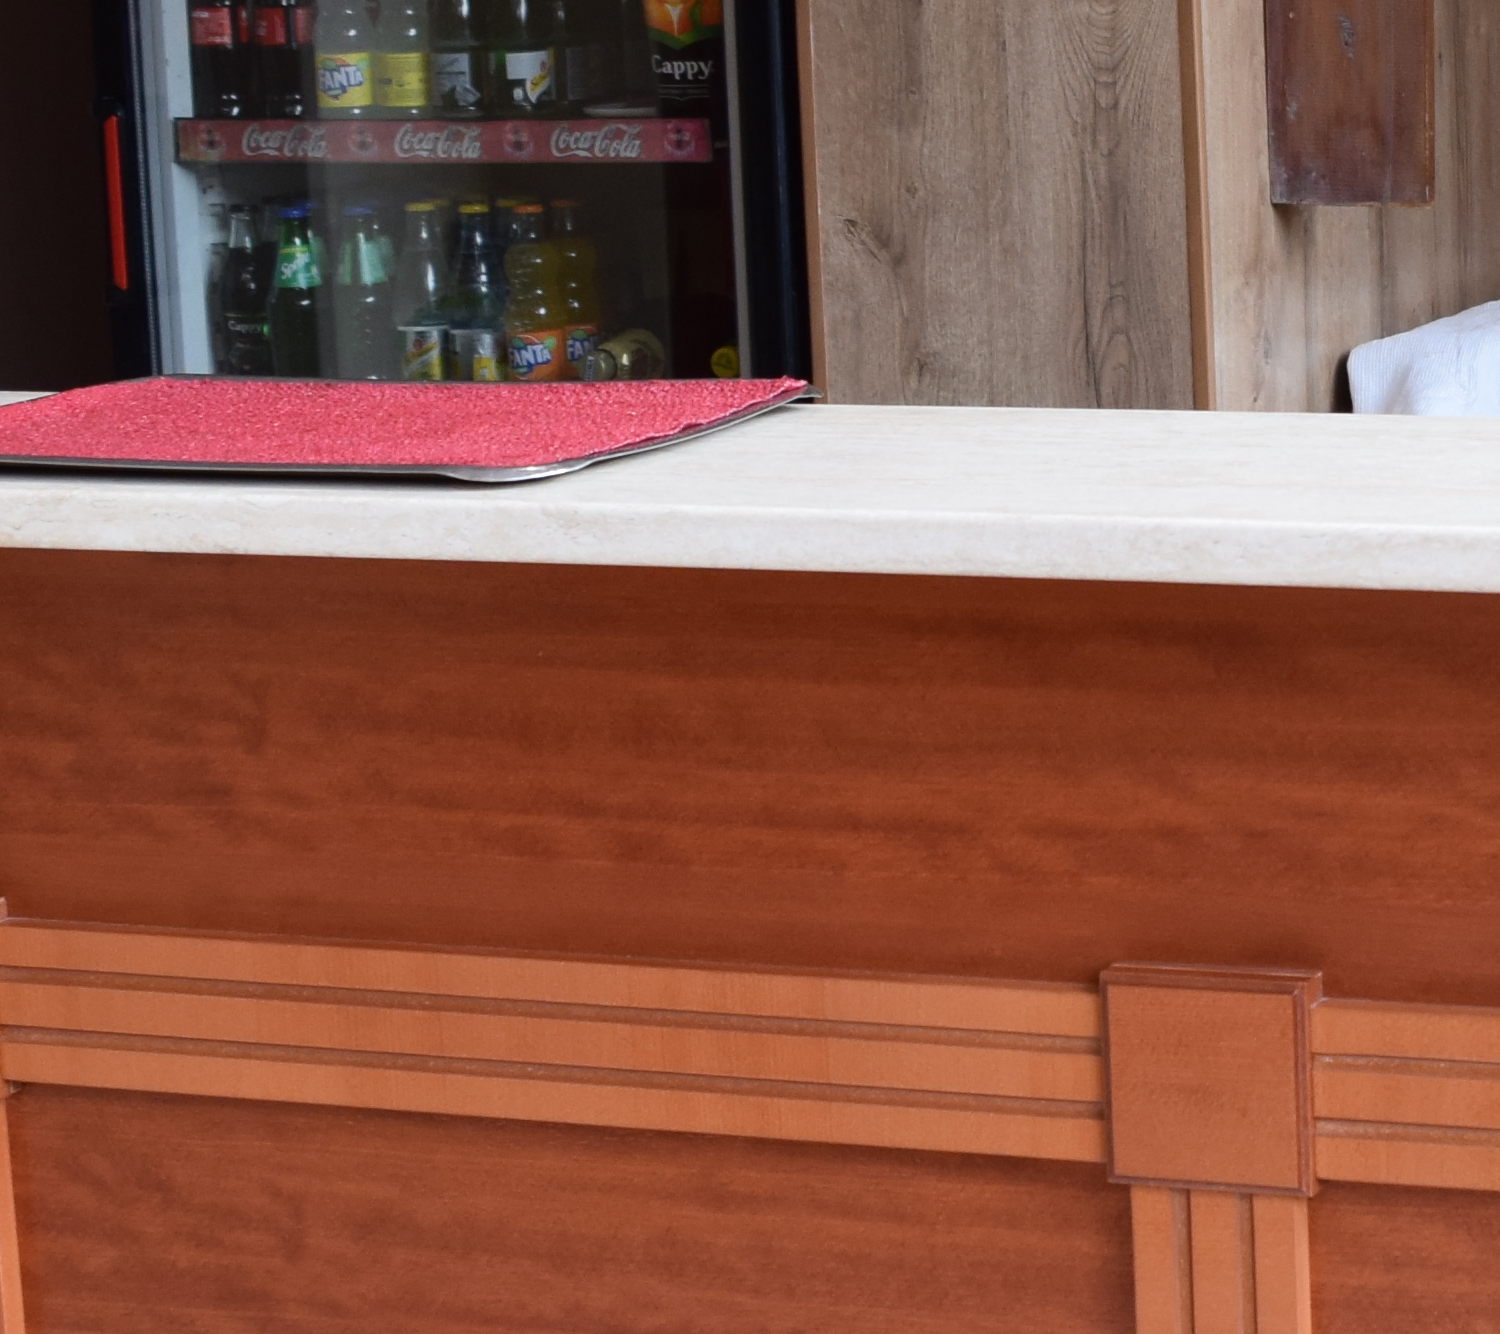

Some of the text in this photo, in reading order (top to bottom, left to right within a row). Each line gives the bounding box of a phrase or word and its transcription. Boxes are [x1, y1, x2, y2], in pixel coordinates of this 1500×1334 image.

[318, 64, 364, 91] FANTA
[652, 55, 713, 81] Cappy
[242, 123, 327, 159] Coca-Cola
[394, 123, 482, 159] Coca-Cola
[550, 123, 642, 159] Coca-Cola
[509, 343, 552, 366] FANTA
